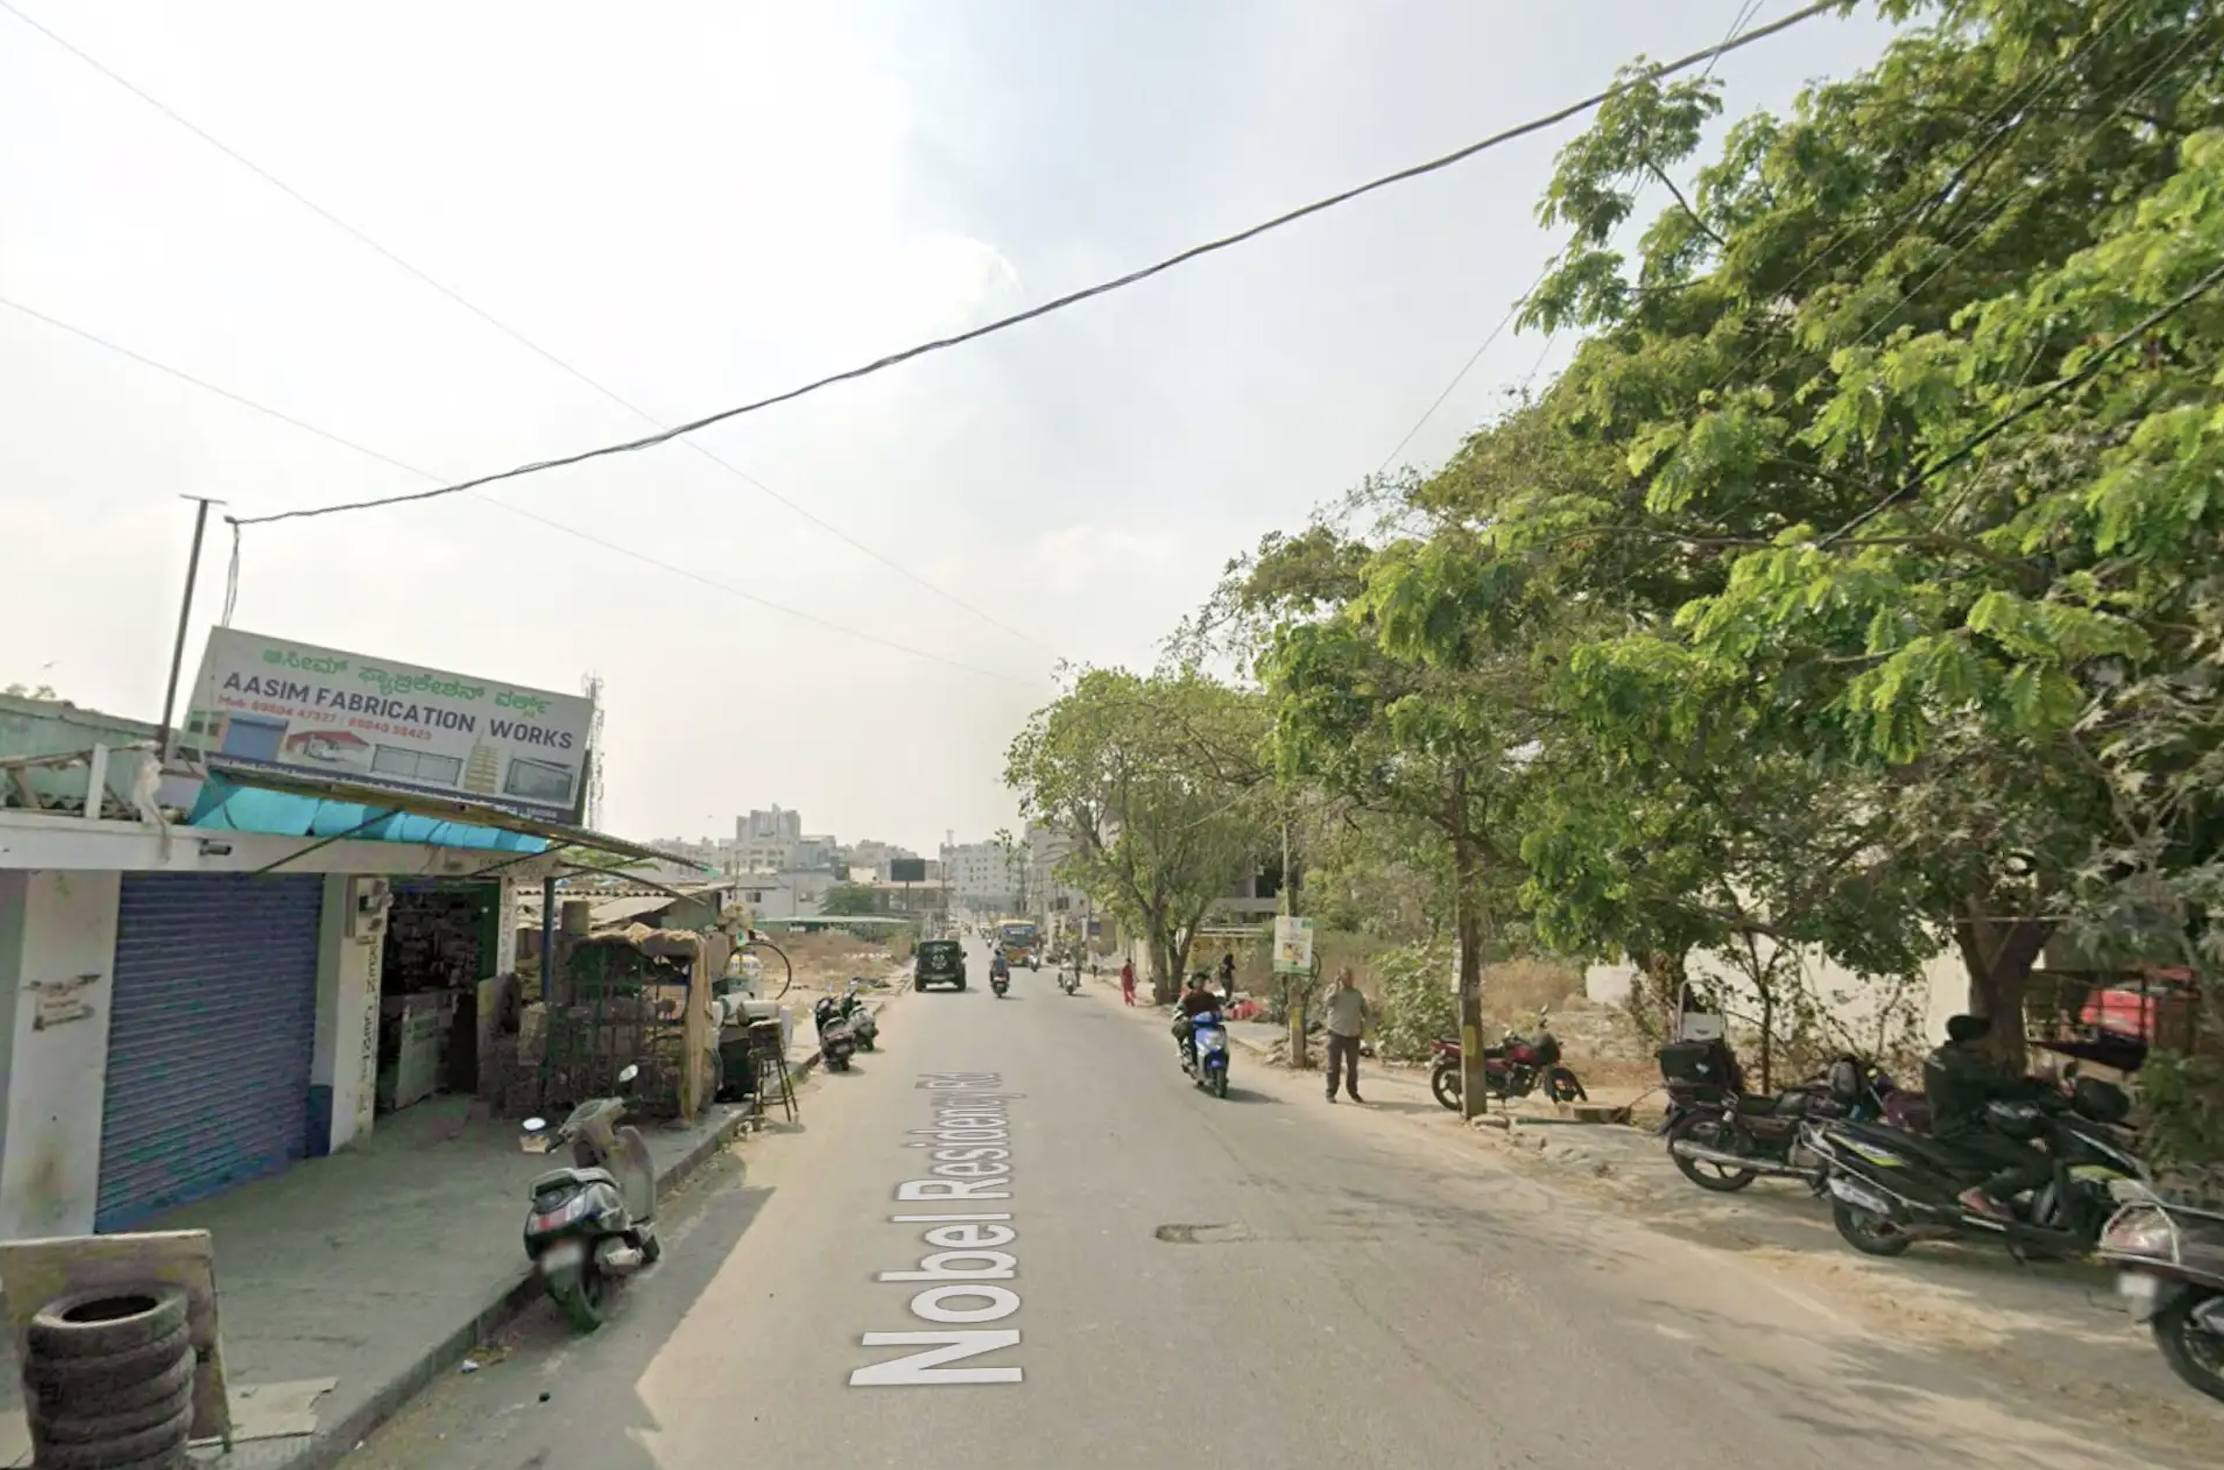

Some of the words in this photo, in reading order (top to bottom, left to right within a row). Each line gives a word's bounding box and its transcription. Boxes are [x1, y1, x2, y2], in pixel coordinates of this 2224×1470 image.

[223, 671, 311, 704] AASIM
[314, 688, 476, 733] FABRICATION
[489, 718, 574, 750] WORKS
